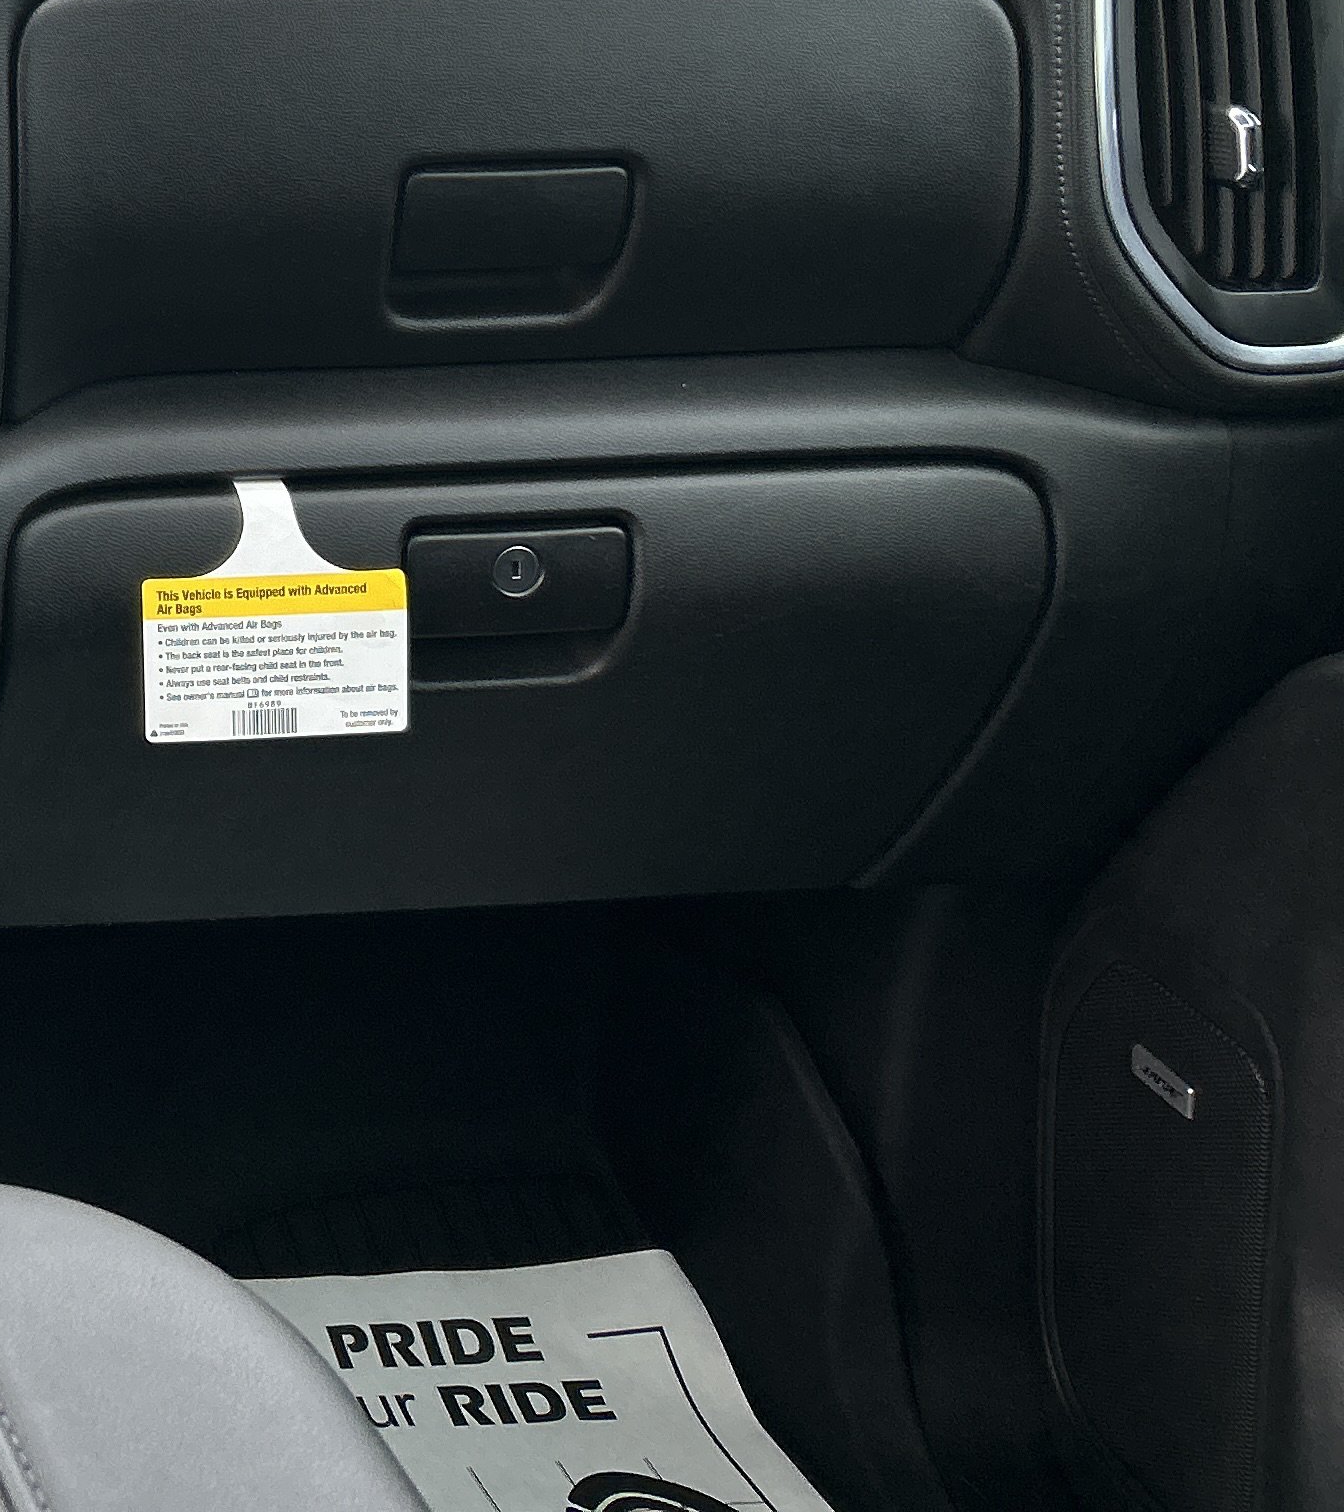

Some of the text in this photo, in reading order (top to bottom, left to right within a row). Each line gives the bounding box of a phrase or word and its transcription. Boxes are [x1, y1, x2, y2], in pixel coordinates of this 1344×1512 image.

[156, 582, 367, 602] This Vehicle is Equipped with Advanced
[156, 603, 202, 617] Air Bags
[157, 619, 282, 633] Even with Advanced Air Bags
[165, 636, 199, 647] Children
[202, 638, 217, 646] can
[220, 636, 230, 645] be
[268, 633, 305, 644] seriously
[308, 631, 336, 643] injured
[338, 631, 348, 641] by
[351, 630, 364, 639] the
[366, 630, 377, 638] air
[379, 629, 397, 639] bag.
[165, 652, 180, 660] The
[182, 651, 201, 660] back
[203, 651, 220, 659] seat
[232, 649, 244, 658] the
[273, 648, 293, 657] place
[296, 647, 307, 655] for
[192, 665, 204, 675] put
[259, 662, 278, 670] child
[280, 660, 297, 669] seat
[308, 660, 321, 668] the
[166, 679, 194, 688] Always
[213, 677, 230, 686] seat
[340, 710, 348, 718] To
[390, 708, 398, 717] by
[325, 1316, 545, 1370] PRIDE
[436, 1379, 618, 1428] RIDE
